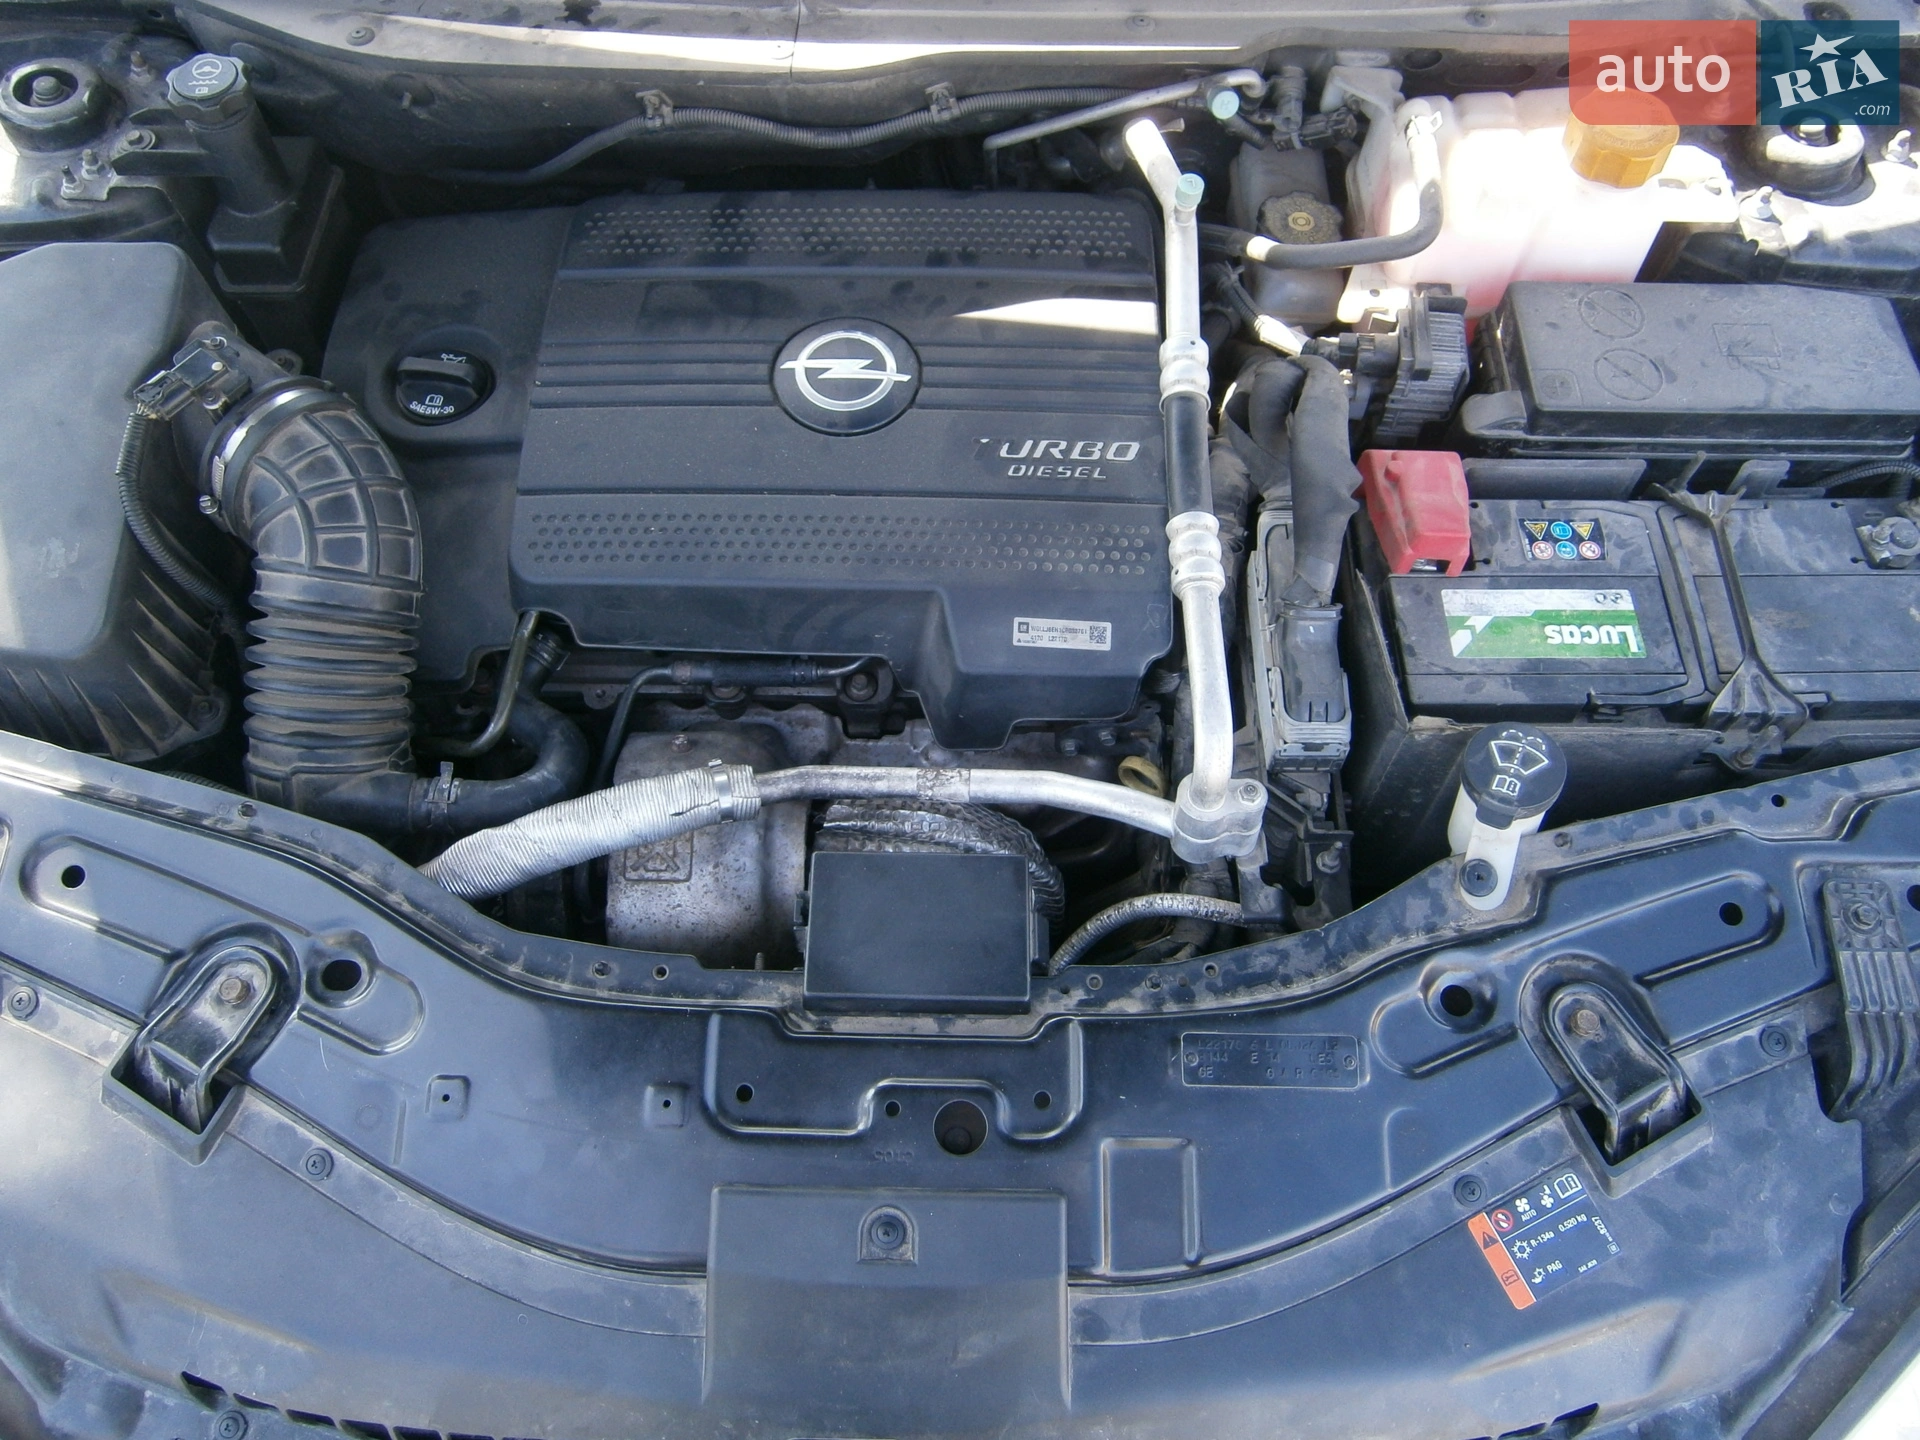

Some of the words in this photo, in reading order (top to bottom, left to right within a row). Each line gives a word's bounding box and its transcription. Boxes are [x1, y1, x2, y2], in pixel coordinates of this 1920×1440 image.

[1007, 464, 1107, 479] DIESEL
[1544, 625, 1639, 653] Lucas
[1521, 1209, 1537, 1222] AUTO
[1530, 1231, 1555, 1247] R-134a
[1558, 1218, 1577, 1232] 0.520
[1577, 1213, 1587, 1224] kg
[1546, 1260, 1563, 1274] PAG
